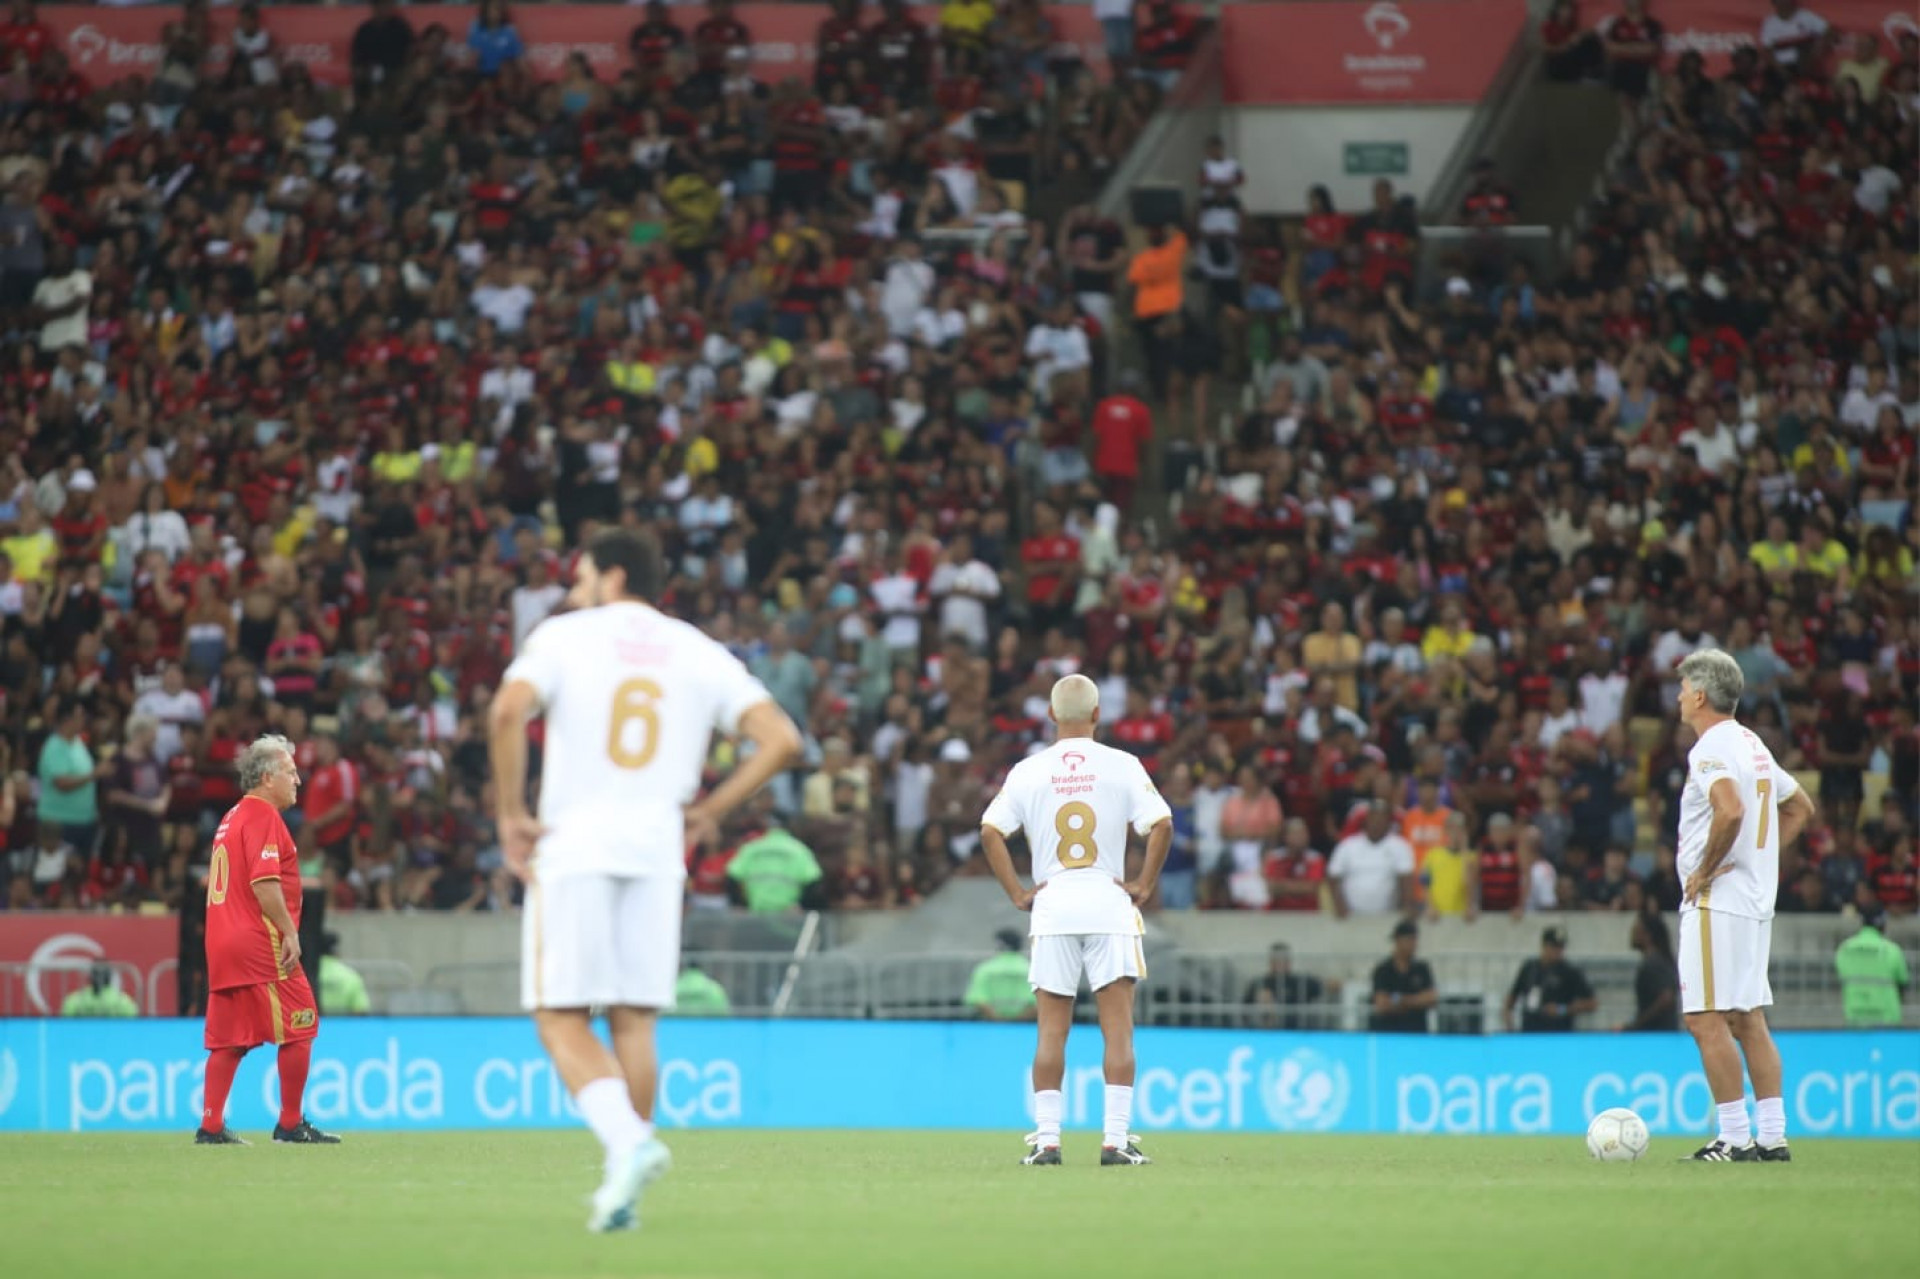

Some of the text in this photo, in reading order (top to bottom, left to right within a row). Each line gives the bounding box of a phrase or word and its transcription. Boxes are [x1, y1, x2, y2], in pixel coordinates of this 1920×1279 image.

[607, 676, 665, 770] 6
[1051, 774, 1096, 784] bradesco
[1055, 784, 1093, 796] seguros
[1055, 800, 1098, 870] 8
[1756, 778, 1772, 850] 7
[1396, 1071, 1552, 1134] para
